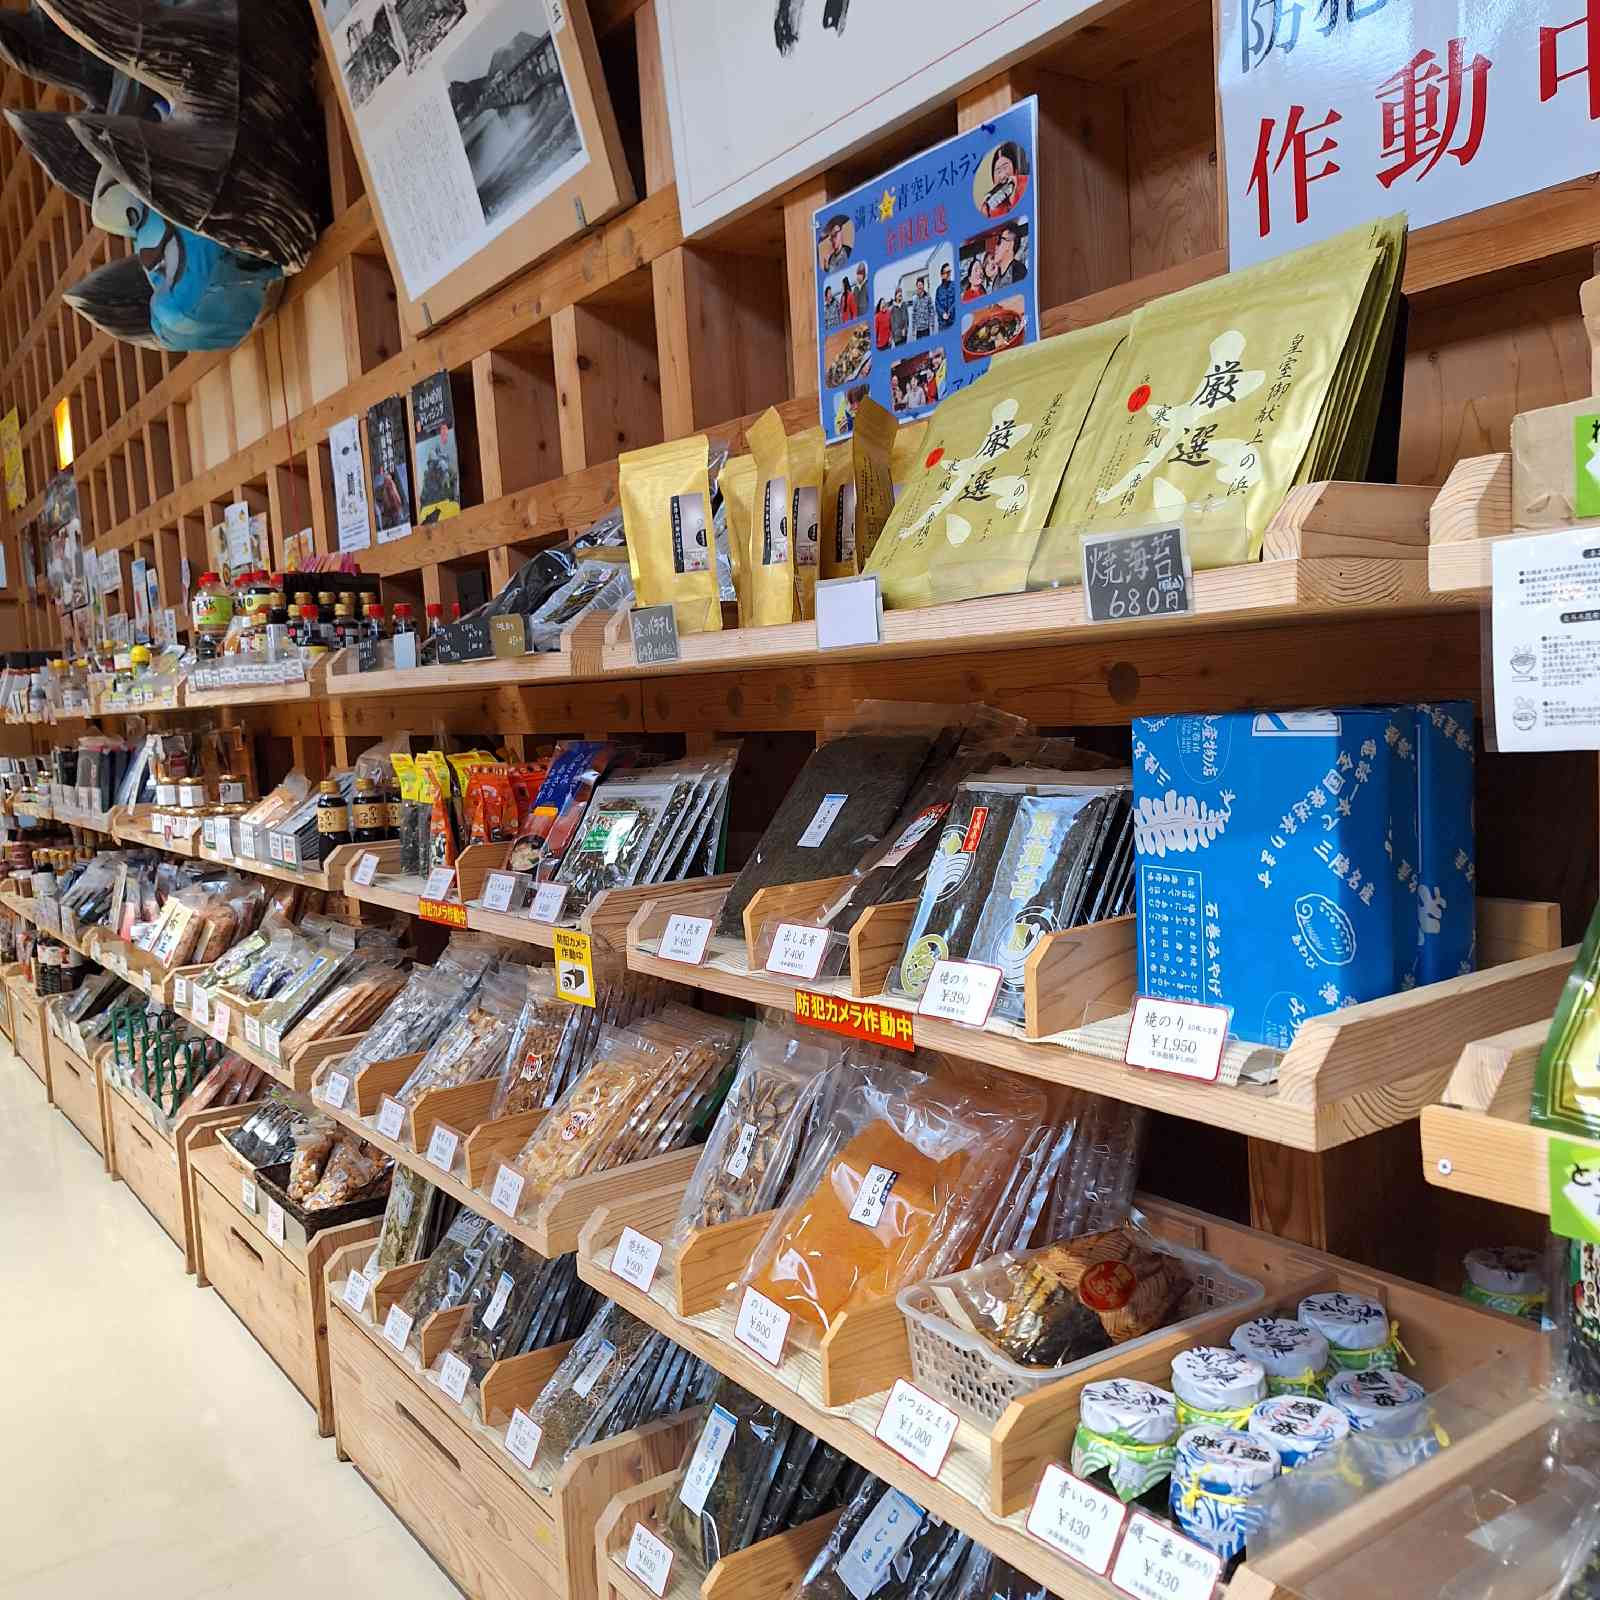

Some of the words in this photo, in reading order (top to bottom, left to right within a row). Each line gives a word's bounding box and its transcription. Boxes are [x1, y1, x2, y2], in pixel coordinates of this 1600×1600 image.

[1168, 360, 1243, 467] 厳選
[958, 419, 1015, 502] 厳選
[1088, 534, 1174, 588] 焼海苔
[556, 933, 588, 949] 防犯カメラ
[560, 947, 585, 960] 作動中
[1205, 901, 1225, 999] 石巻みやげ
[795, 991, 914, 1042] 防犯カメラ作動中
[1144, 1011, 1185, 1033] 焼のり
[1151, 1034, 1198, 1055] ¥1,950
[860, 1172, 887, 1221] のしいか
[900, 1413, 933, 1449] ¥1,000
[1057, 1507, 1091, 1540] ¥430
[1143, 1558, 1181, 1593] ¥430
